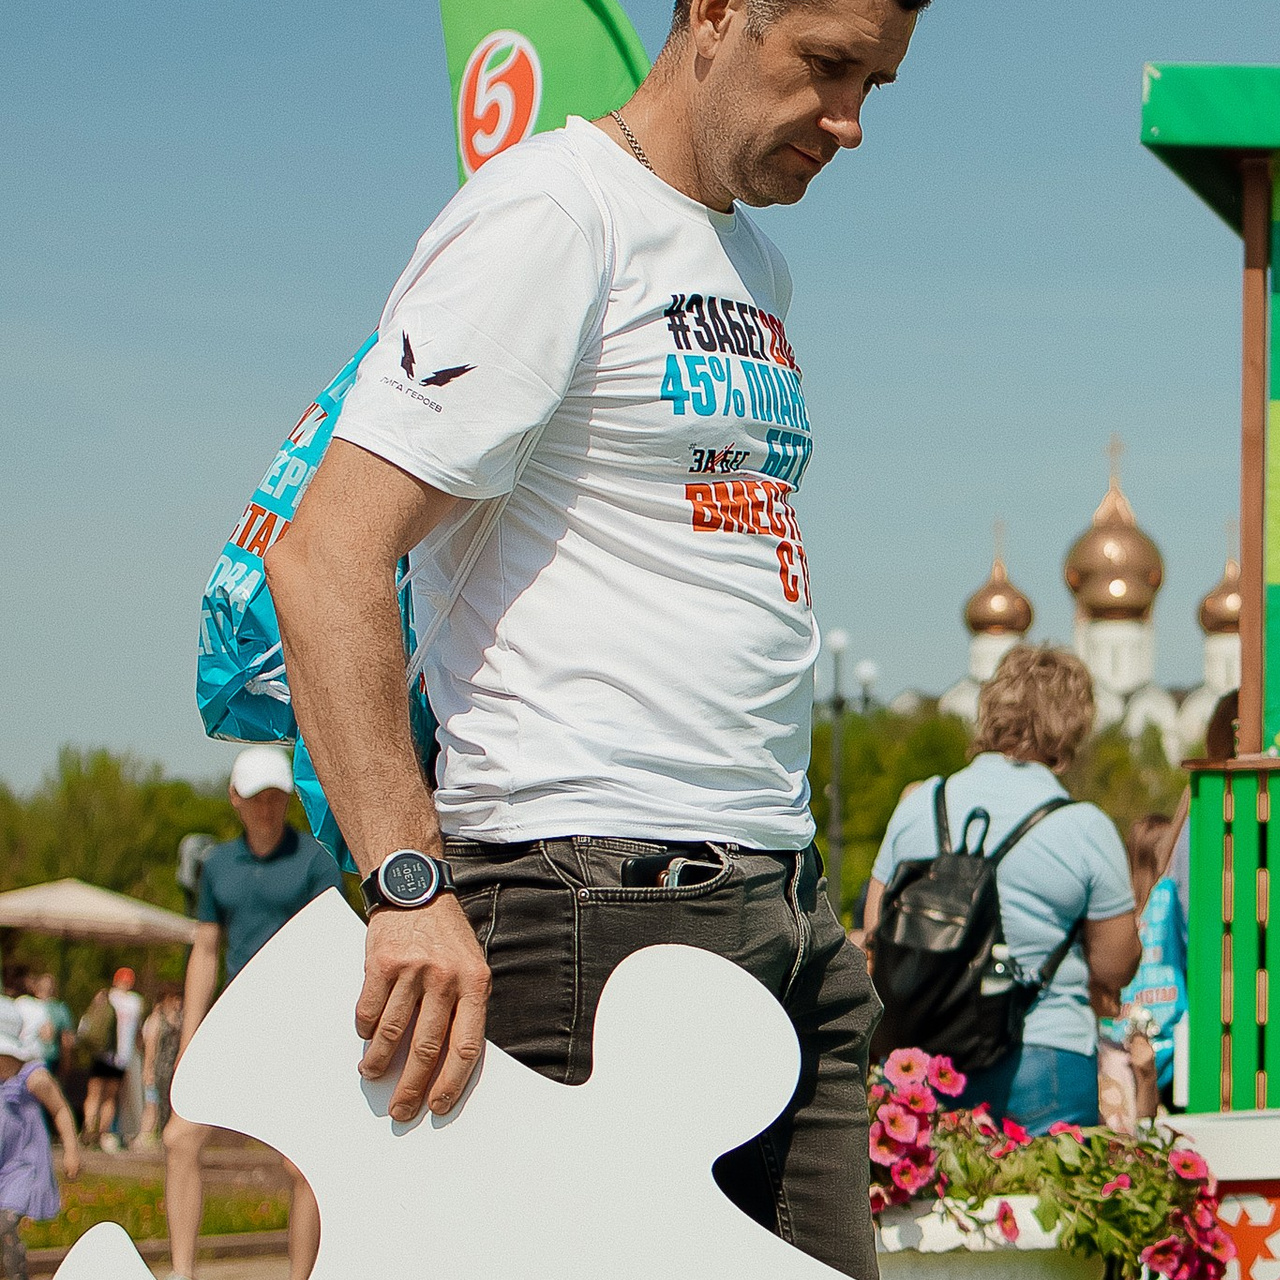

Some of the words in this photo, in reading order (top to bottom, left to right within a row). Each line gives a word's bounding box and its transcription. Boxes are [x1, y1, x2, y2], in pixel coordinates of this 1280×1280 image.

[380, 376, 403, 392] ЛИГА
[405, 387, 443, 413] ГЕРОЕВ
[660, 354, 745, 418] 45%
[402, 868, 417, 893] 11:30
